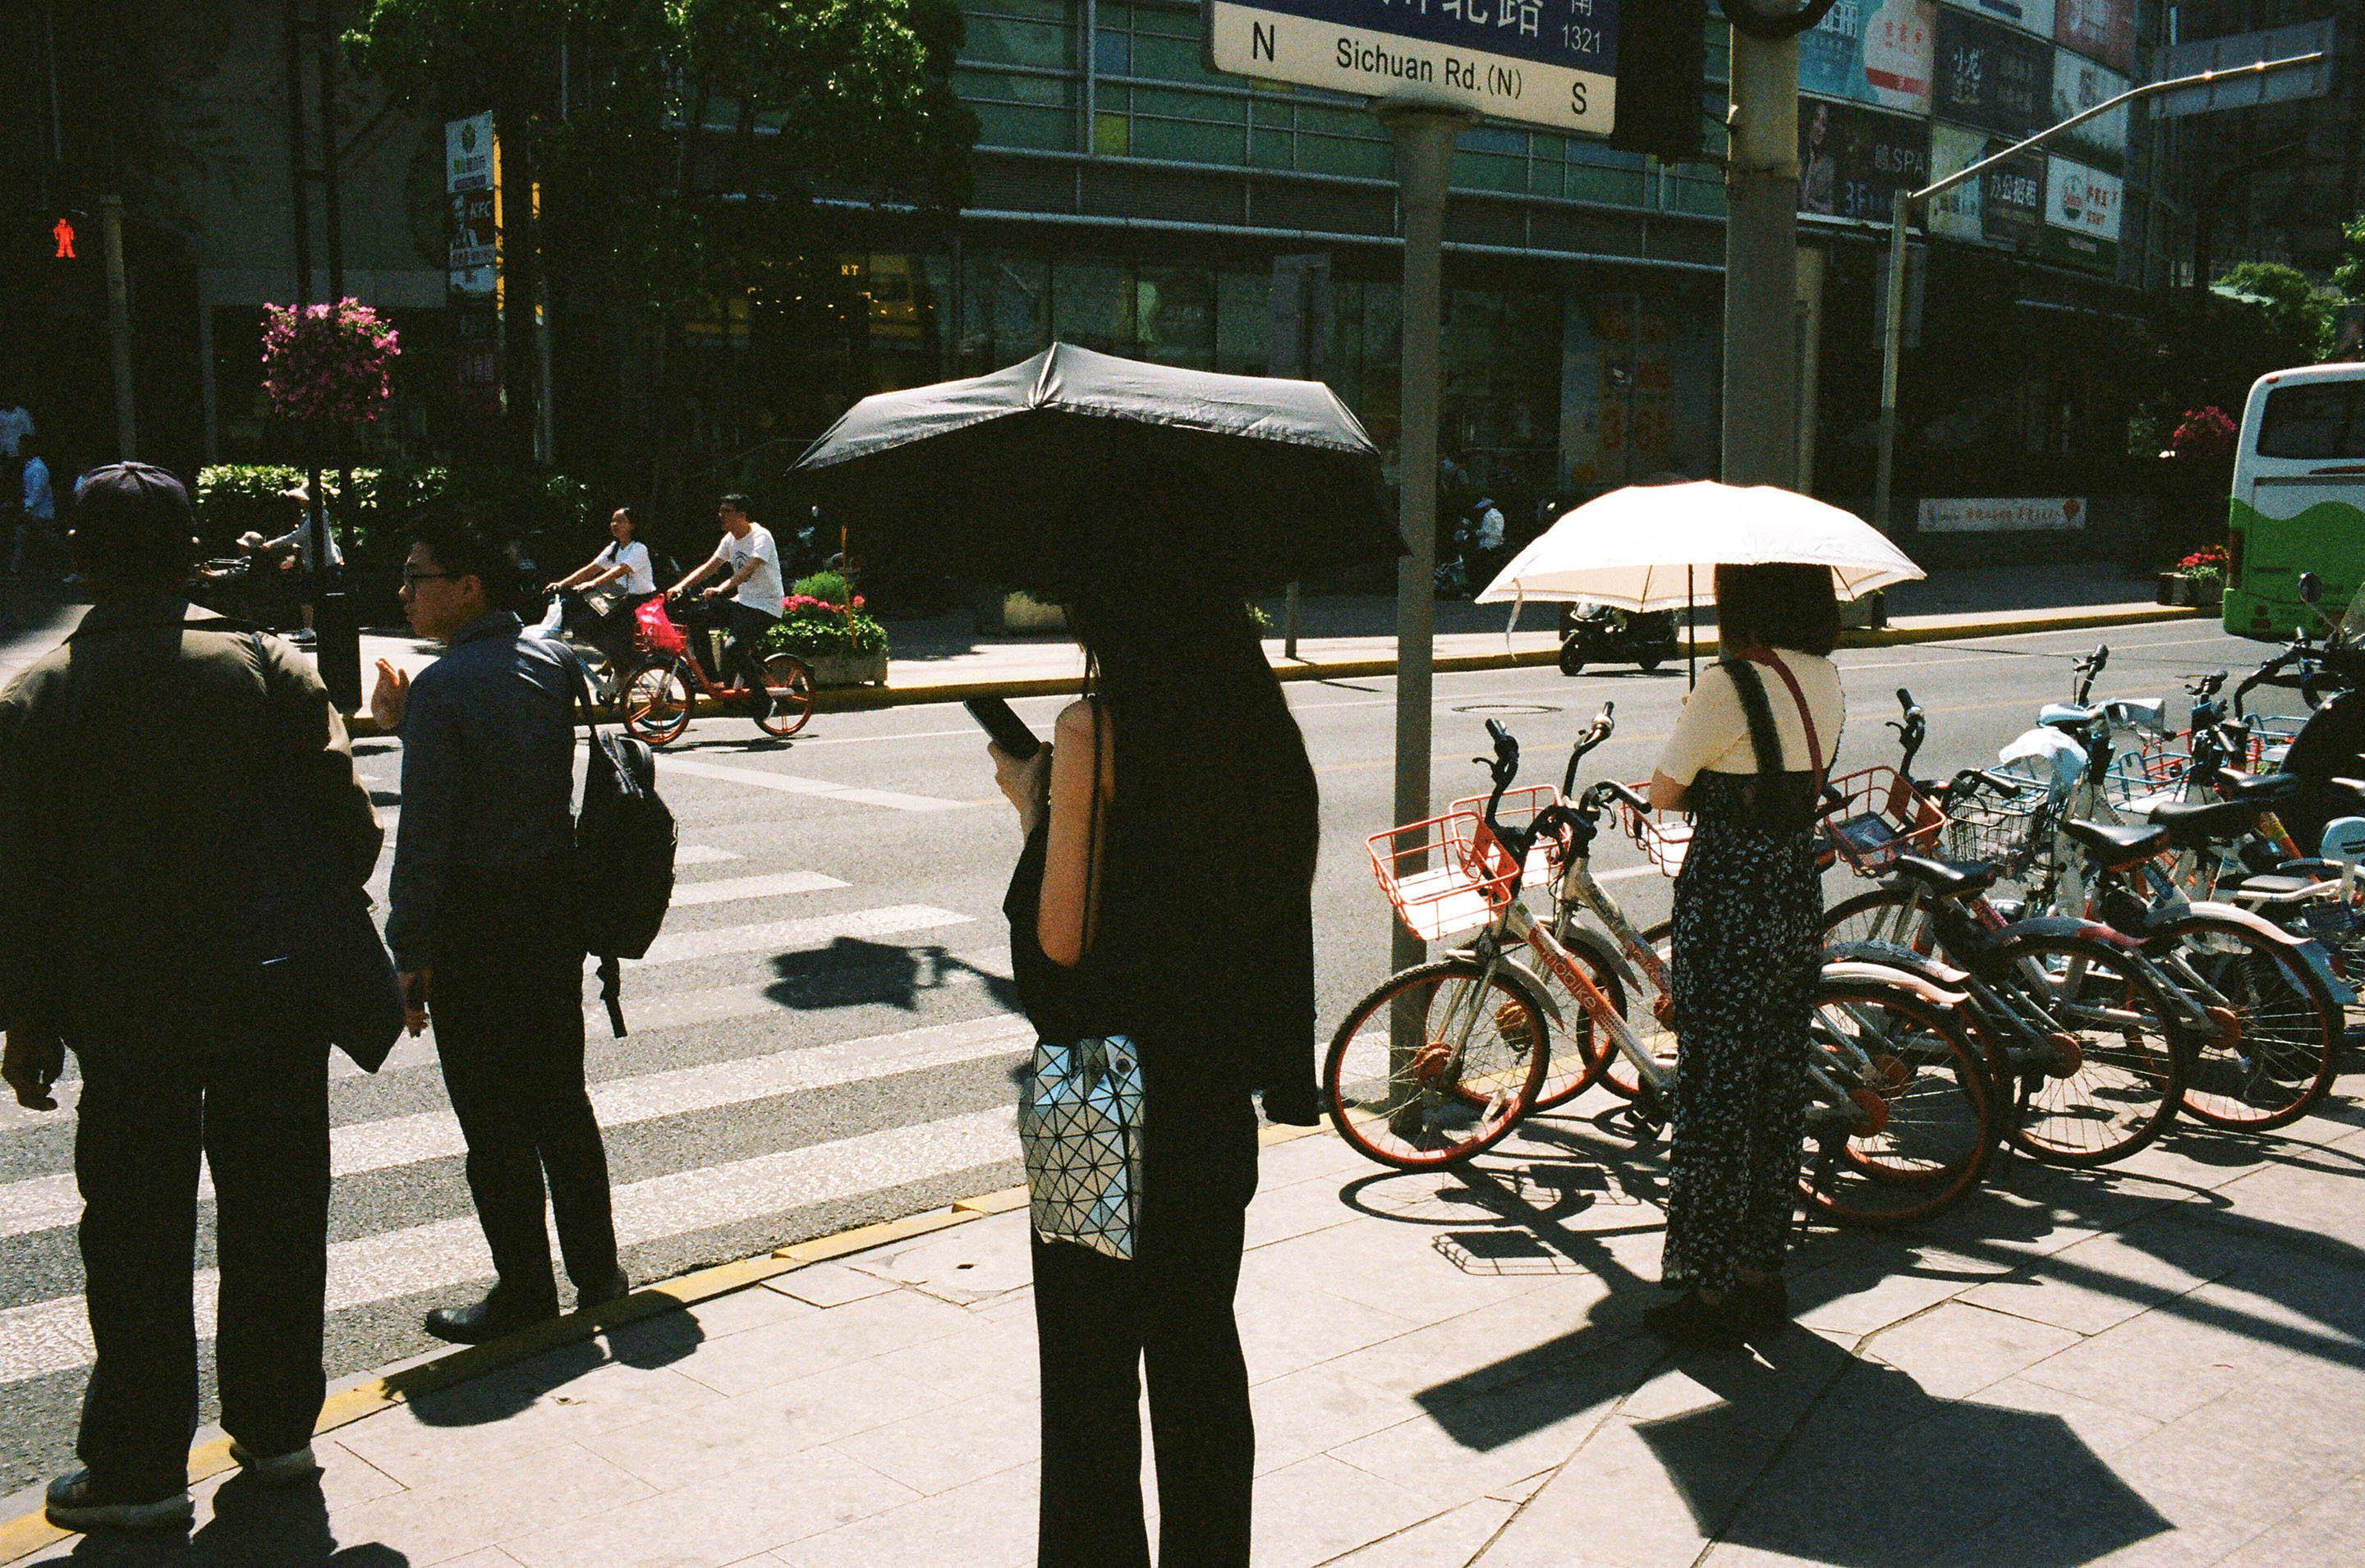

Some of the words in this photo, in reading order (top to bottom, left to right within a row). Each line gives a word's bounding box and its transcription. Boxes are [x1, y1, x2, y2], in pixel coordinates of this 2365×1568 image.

[1252, 21, 1274, 62] N
[1562, 23, 1600, 54] 1321
[1336, 37, 1432, 84] Sichuan
[1572, 82, 1587, 115] S
[470, 200, 492, 219] KFC
